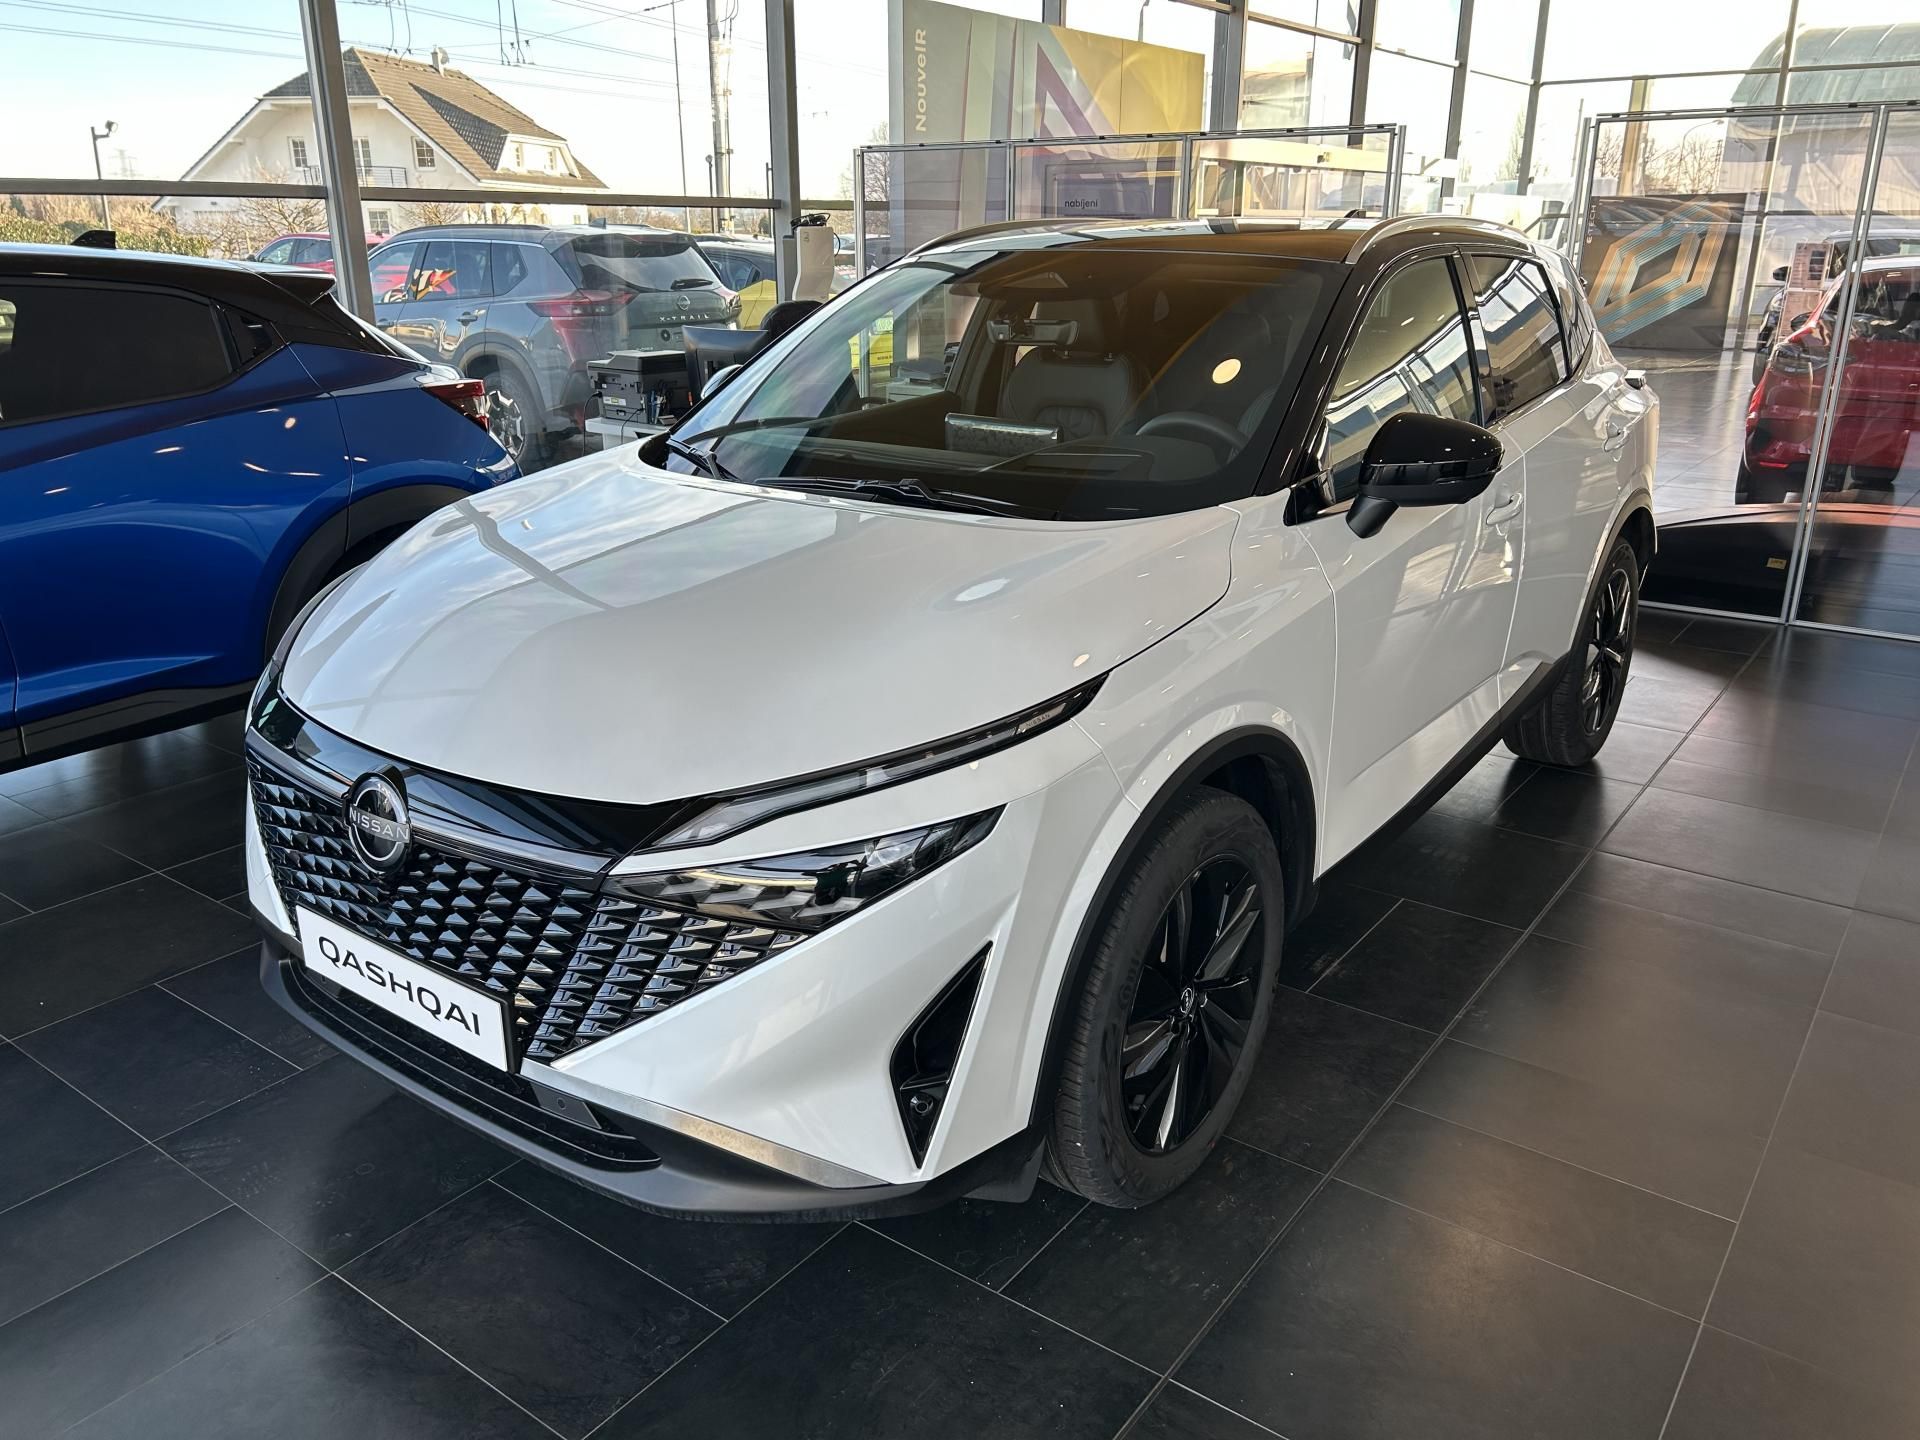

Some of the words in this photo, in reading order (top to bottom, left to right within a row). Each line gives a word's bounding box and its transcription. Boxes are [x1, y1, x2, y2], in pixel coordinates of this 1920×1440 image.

[915, 29, 927, 132] NouvelR
[660, 313, 710, 321] X-TRAIL
[349, 806, 410, 840] NISSAN
[318, 936, 481, 1036] QASHQAI
